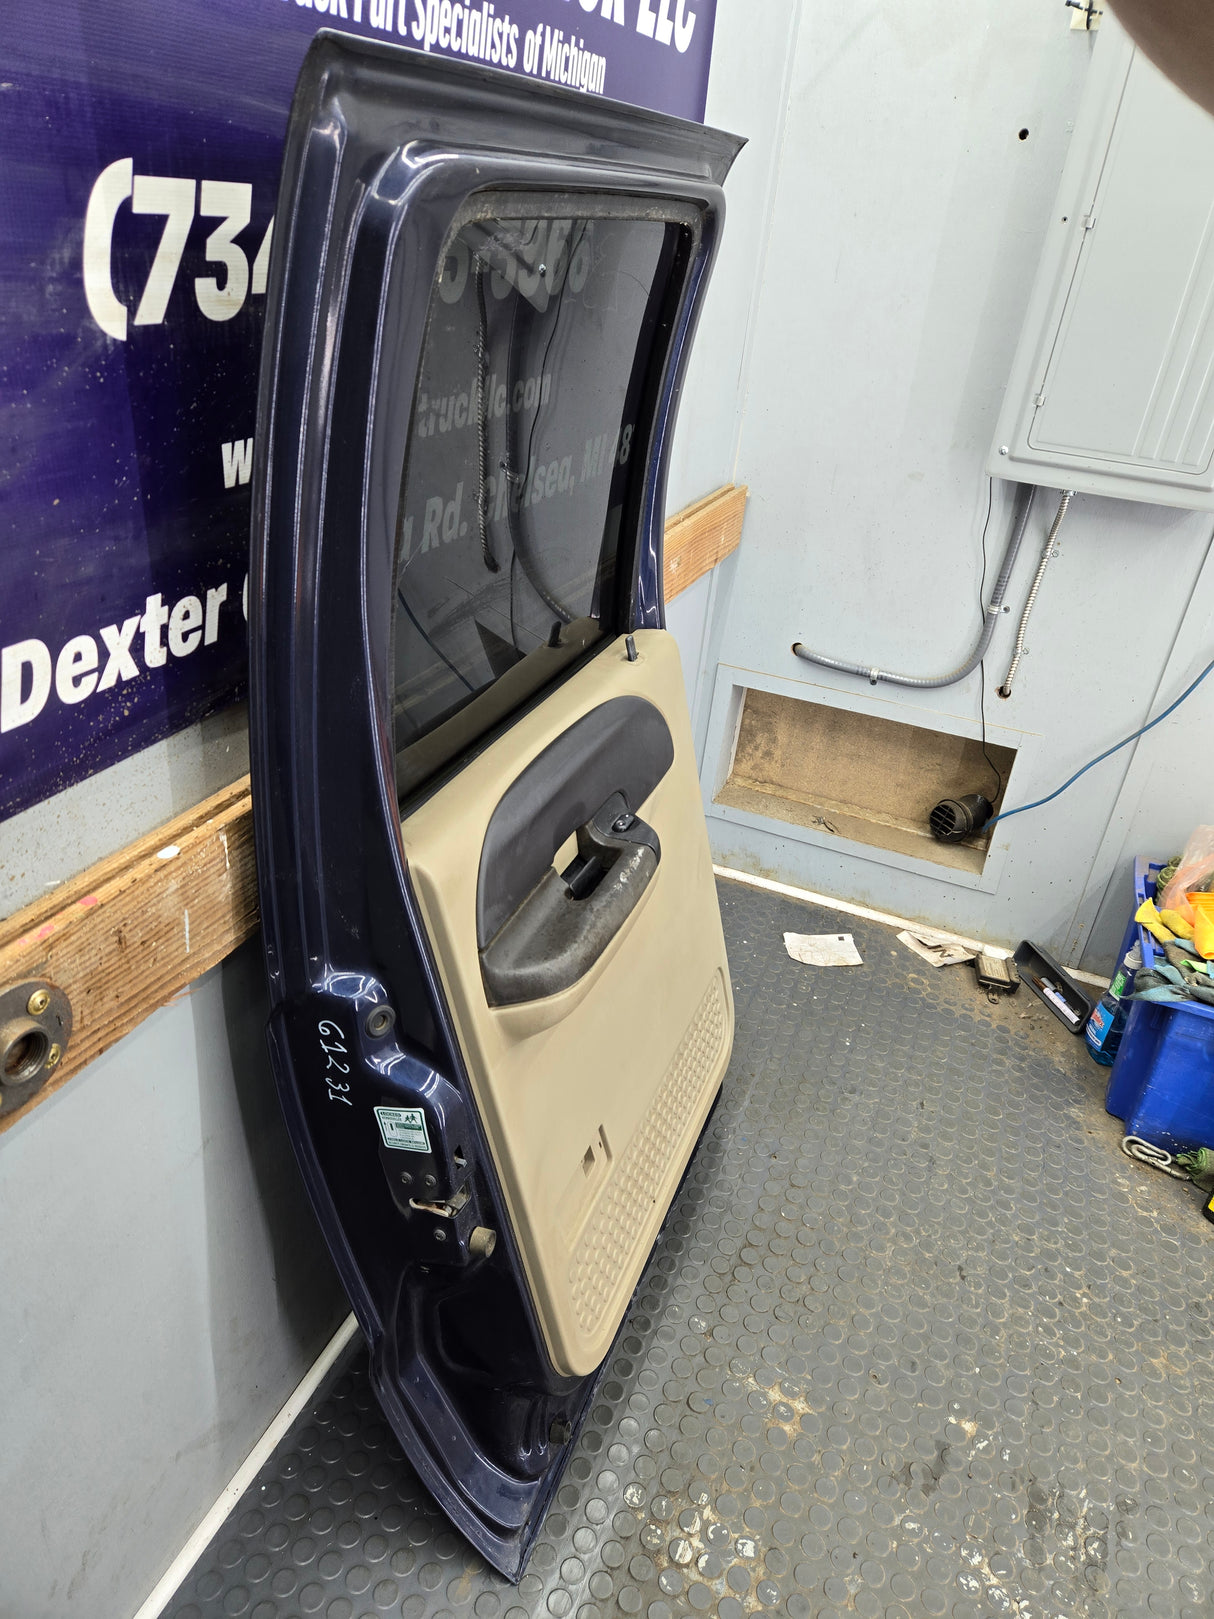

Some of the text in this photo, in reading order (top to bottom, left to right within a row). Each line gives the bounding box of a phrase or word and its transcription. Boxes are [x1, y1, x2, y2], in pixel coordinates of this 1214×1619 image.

[411, 0, 519, 69] Specialists
[523, 23, 543, 75] of
[541, 25, 607, 95] Michigan
[0, 582, 228, 734] Dexter
[421, 481, 467, 553] Rd.
